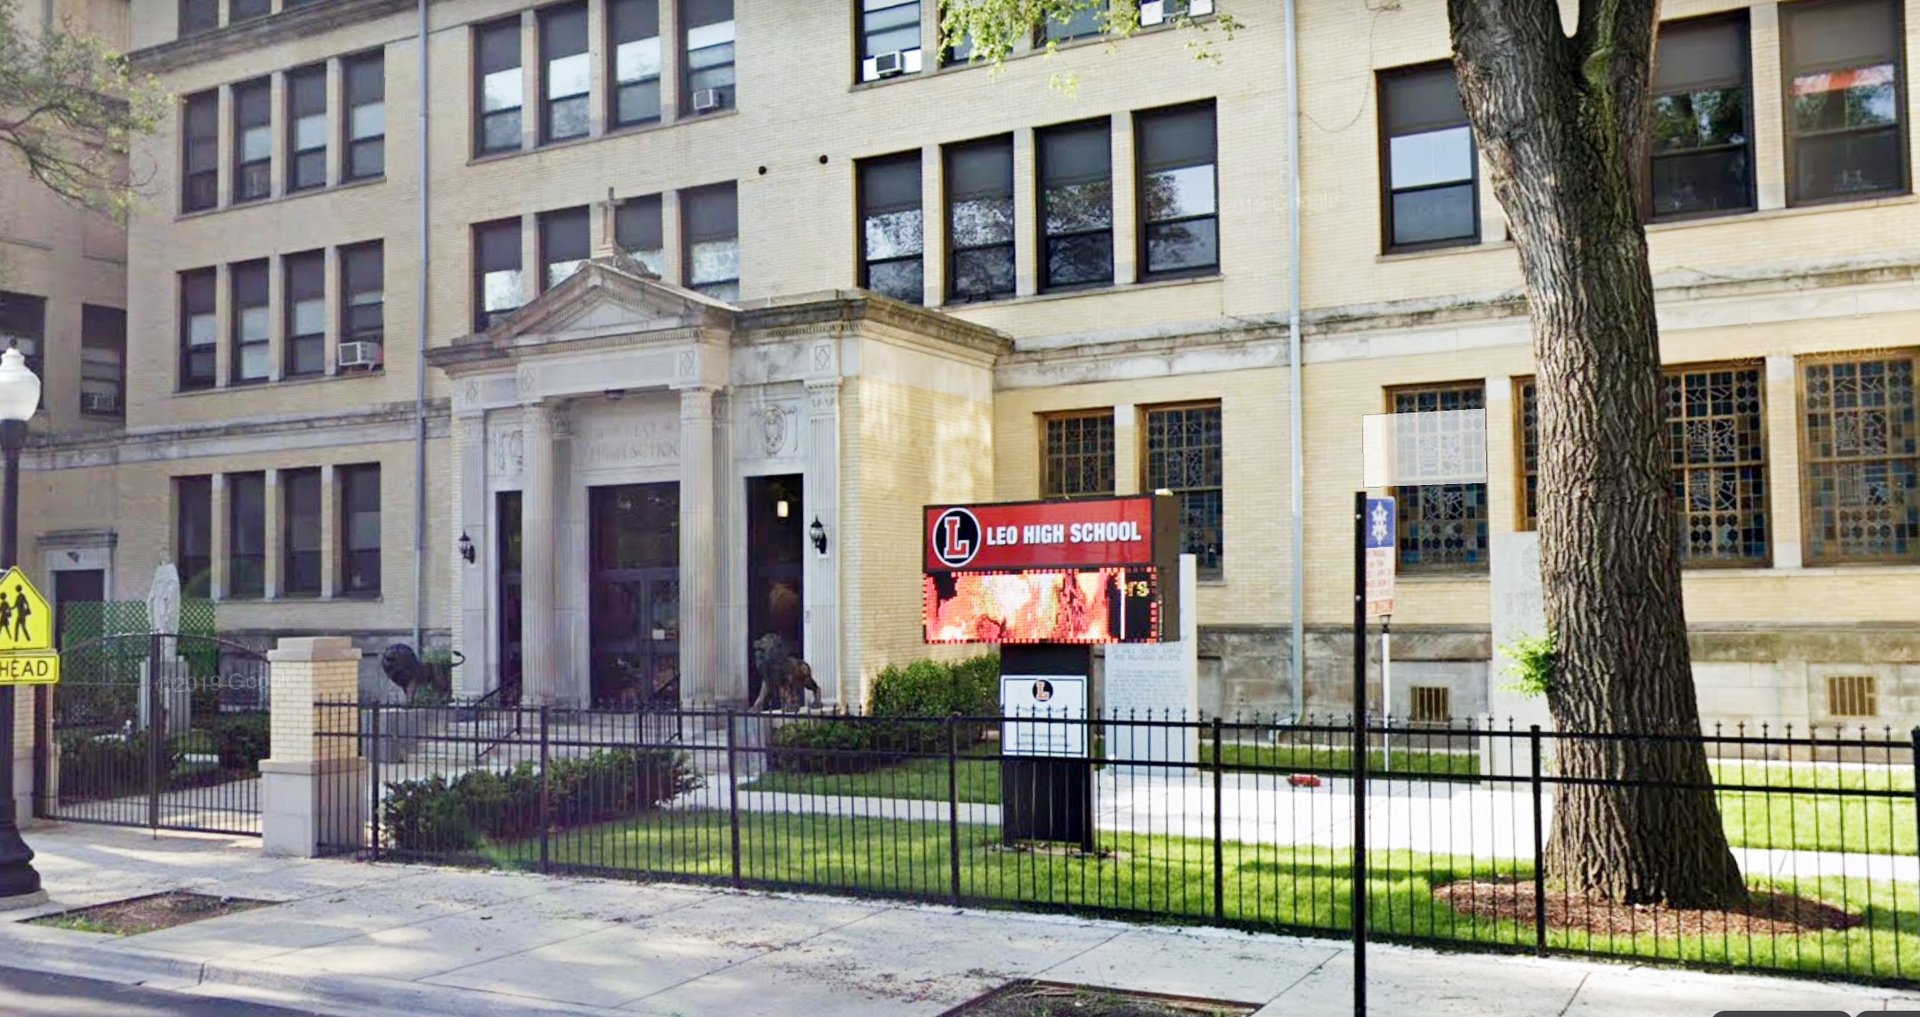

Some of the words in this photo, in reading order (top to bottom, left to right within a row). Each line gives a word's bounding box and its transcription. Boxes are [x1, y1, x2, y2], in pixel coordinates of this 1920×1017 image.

[943, 515, 970, 559] L
[986, 526, 1018, 546] LEO
[1022, 524, 1065, 544] HIGH
[1069, 521, 1142, 543] SCHOOL
[1035, 681, 1050, 701] L
